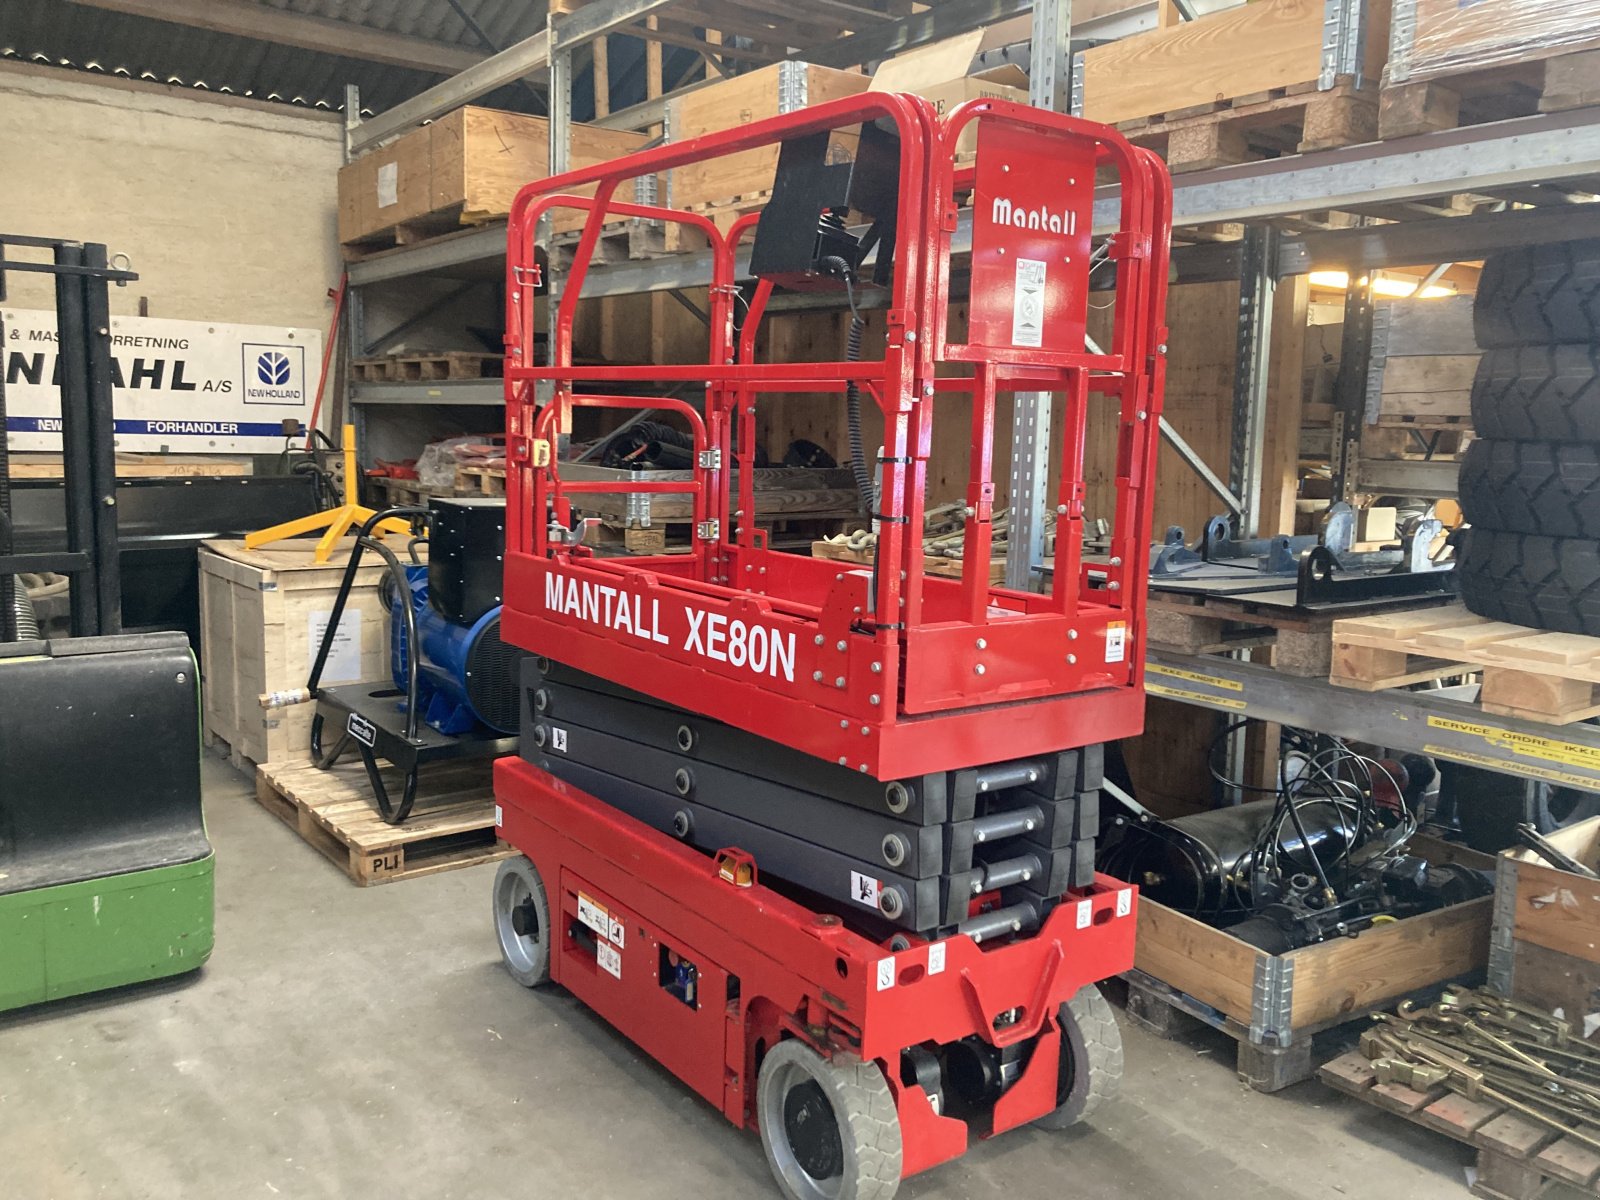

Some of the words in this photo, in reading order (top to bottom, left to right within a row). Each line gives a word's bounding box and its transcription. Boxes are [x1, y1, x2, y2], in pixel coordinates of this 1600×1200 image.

[992, 197, 1076, 236] Mantall
[10, 329, 20, 340] &
[202, 380, 233, 393] A/S
[265, 389, 300, 398] HOLLAND
[38, 420, 62, 431] NEW
[147, 421, 238, 434] FORHANDLER
[545, 571, 669, 645] MANTALL
[683, 606, 796, 683] XE80N
[1434, 719, 1491, 735] SERVICE
[1501, 732, 1550, 747] ORDRE
[1564, 745, 1600, 757] IKKE
[373, 855, 399, 872] PLI
